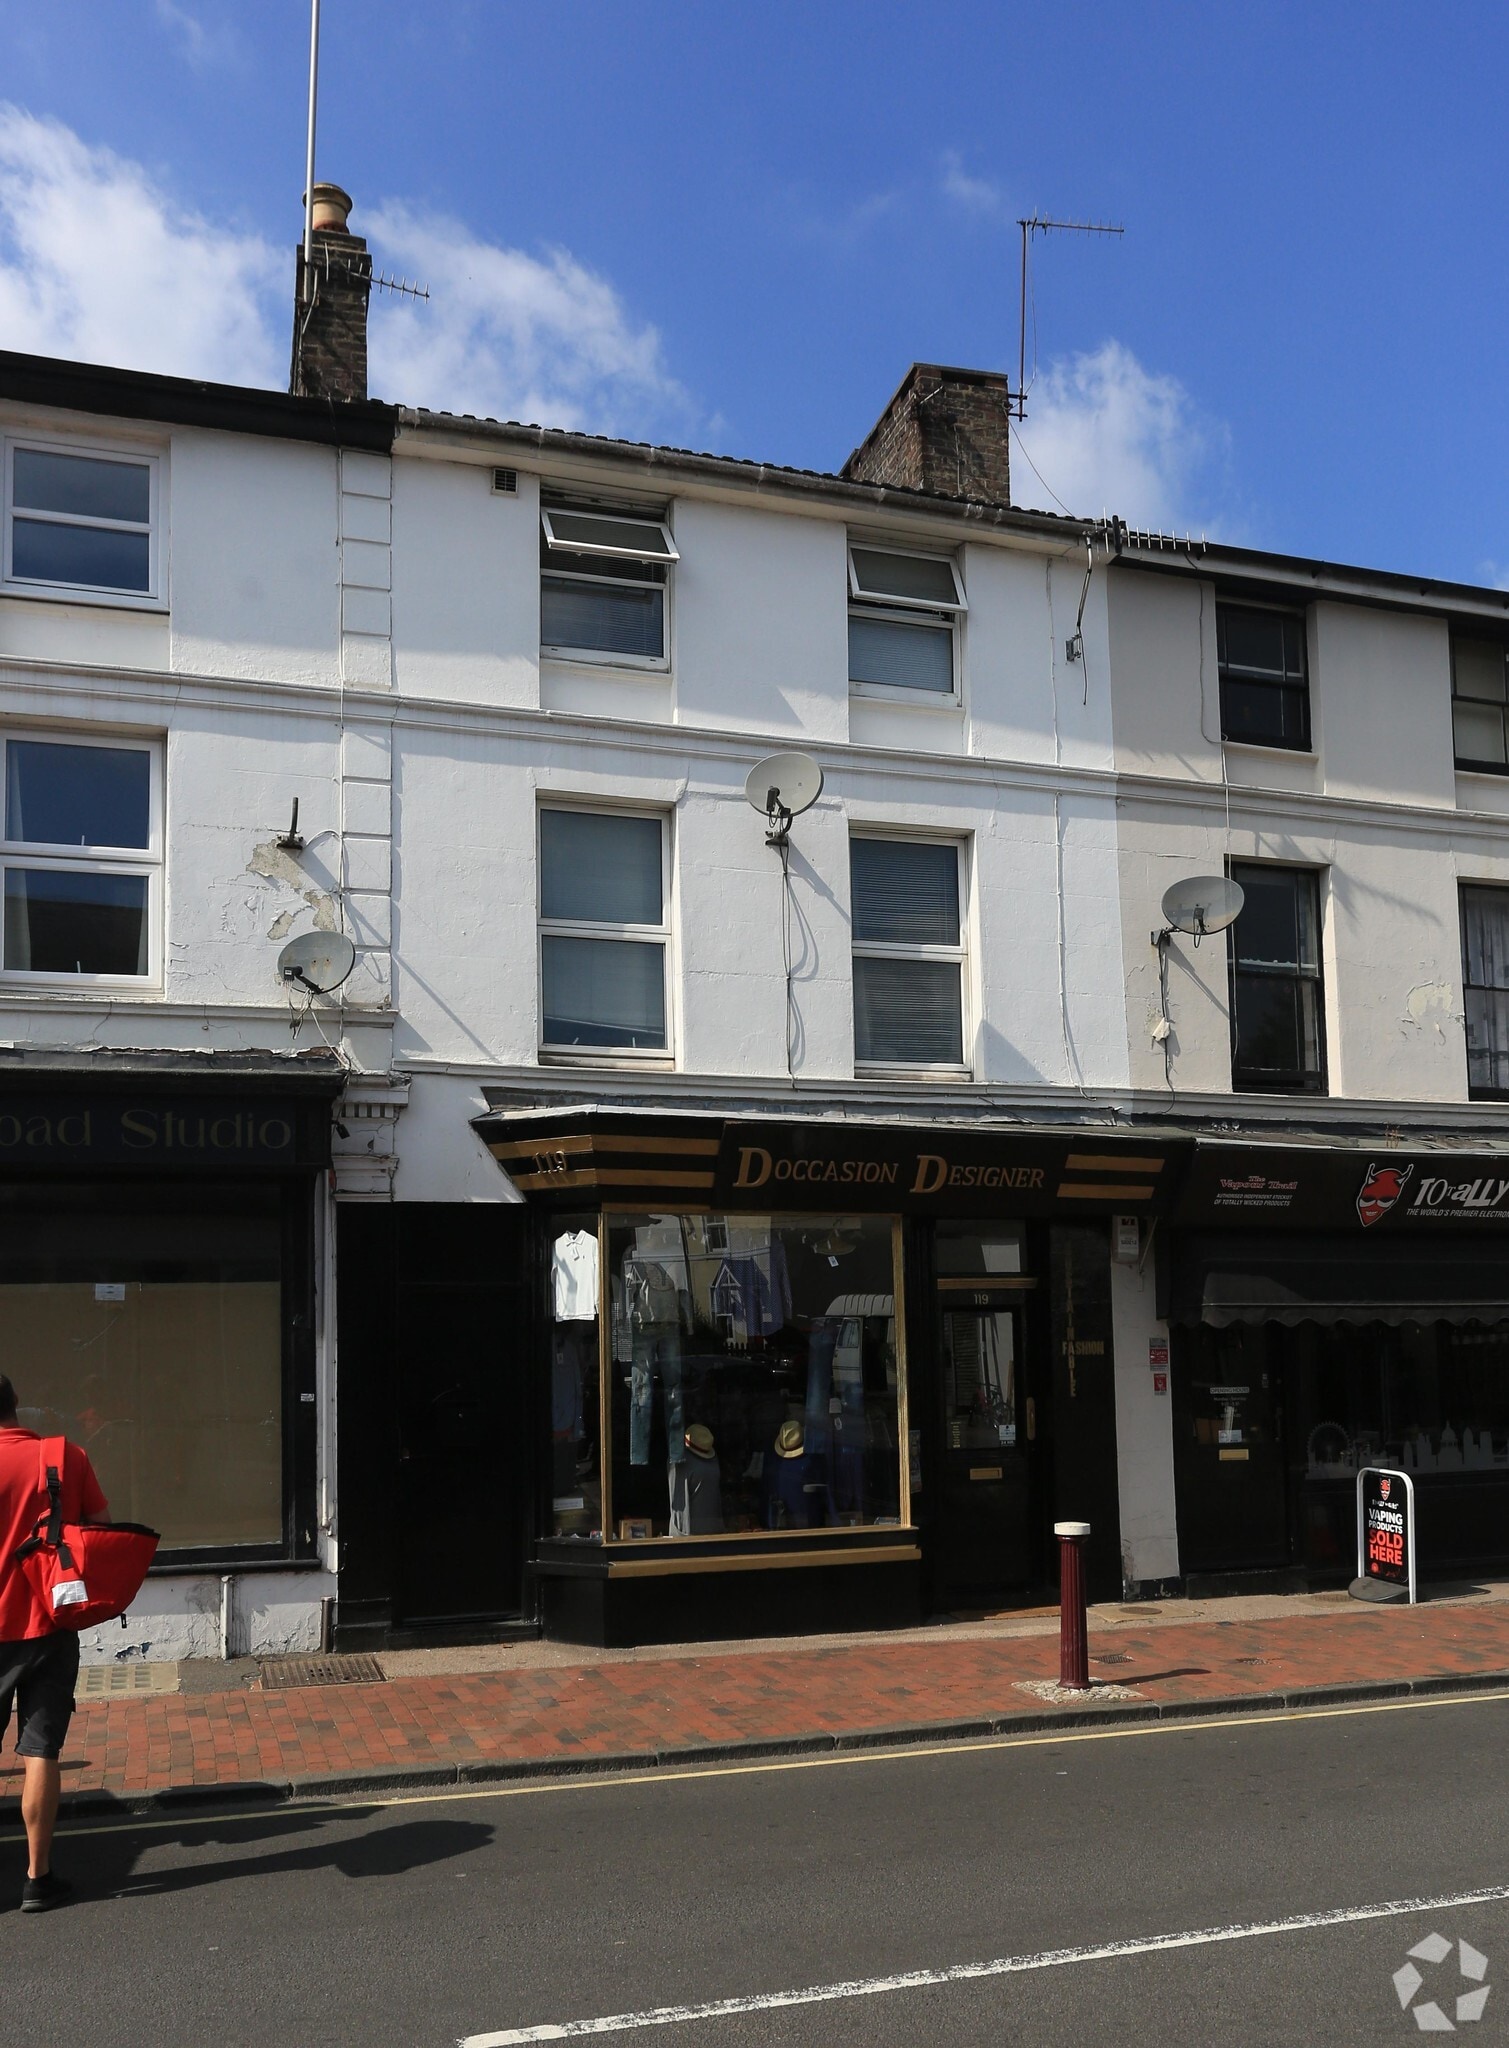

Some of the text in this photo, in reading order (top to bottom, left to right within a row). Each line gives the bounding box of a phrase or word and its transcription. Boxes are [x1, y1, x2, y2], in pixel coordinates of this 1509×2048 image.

[120, 1108, 293, 1150] Studio
[532, 1150, 568, 1174] 119
[732, 1146, 1045, 1194] DOCCASION DESIGNER
[1406, 1208, 1419, 1216] THE
[1419, 1208, 1450, 1217] WORLD'S
[1449, 1209, 1479, 1217] PREMIER
[974, 1293, 989, 1305] 119
[1062, 1341, 1104, 1355] FASHION
[1368, 1508, 1403, 1525] VAPING
[1368, 1519, 1403, 1534] PRODUCTS
[1369, 1528, 1403, 1549] SOLD
[1370, 1544, 1403, 1566] HERE
